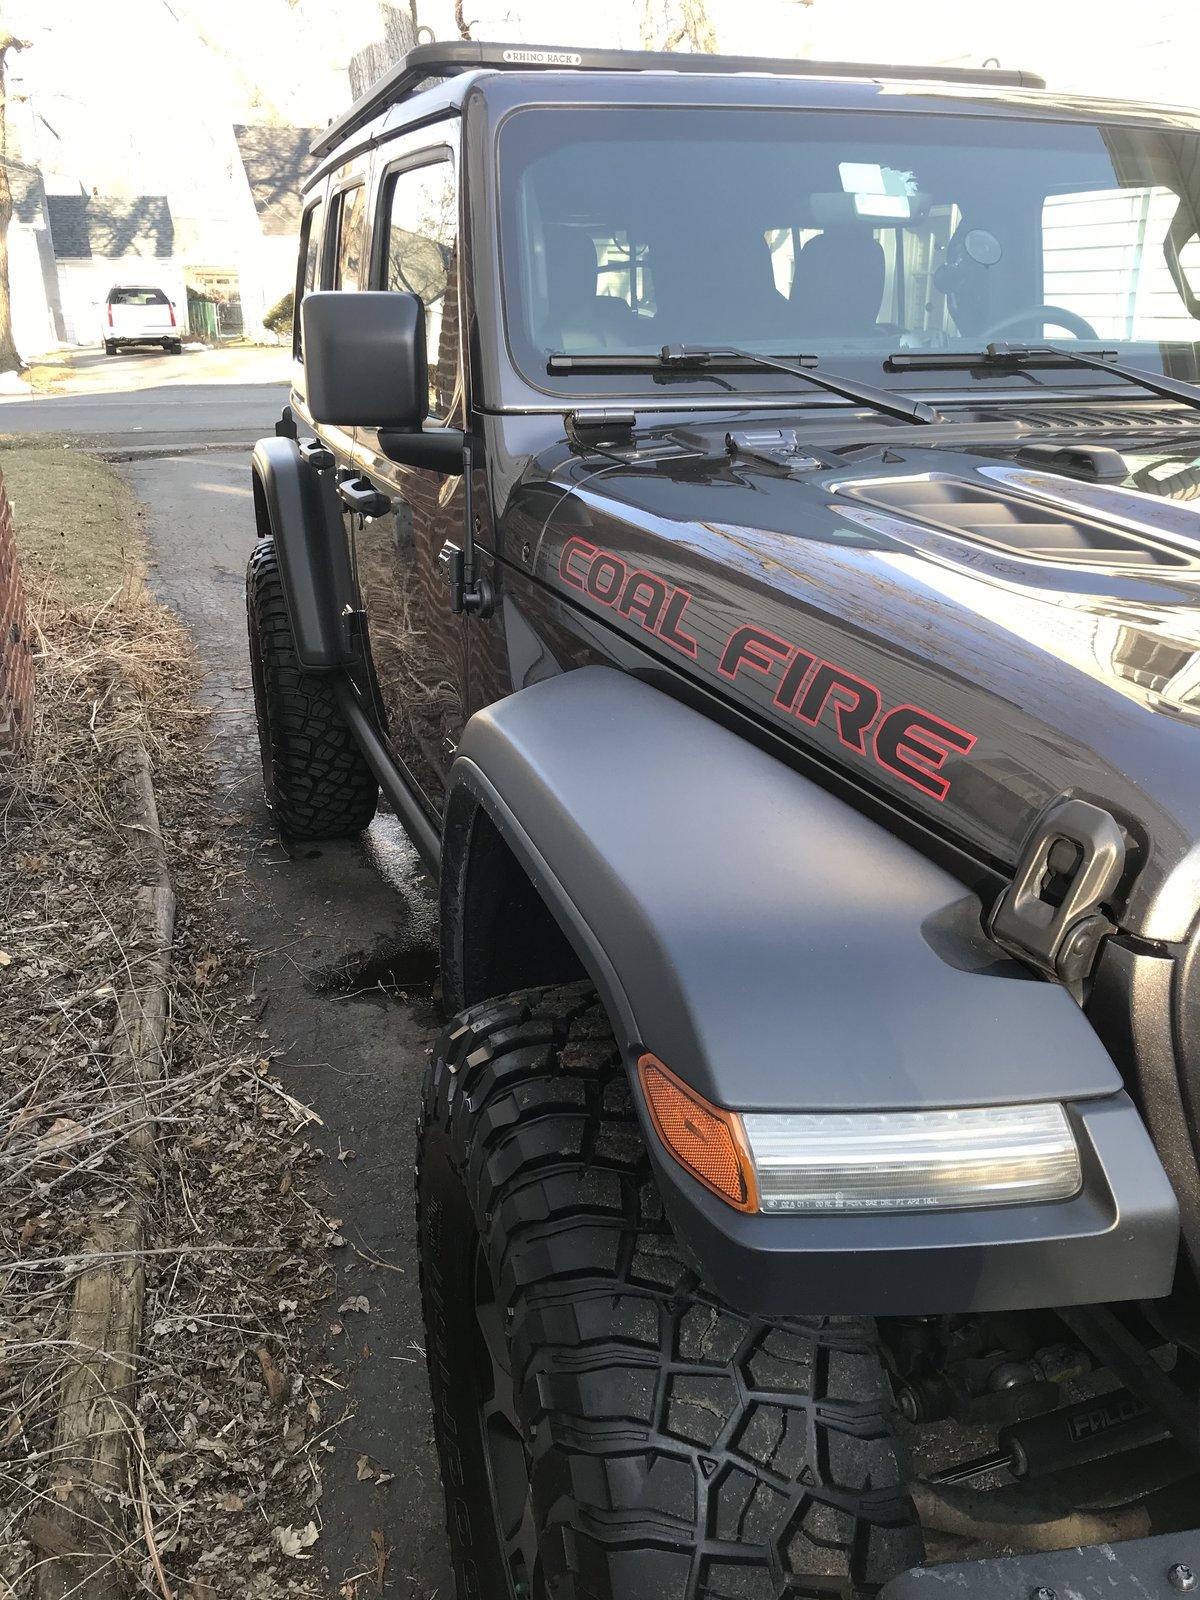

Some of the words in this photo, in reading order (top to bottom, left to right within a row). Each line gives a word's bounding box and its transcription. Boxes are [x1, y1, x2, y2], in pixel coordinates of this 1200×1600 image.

[513, 52, 544, 62] RHINO
[547, 54, 572, 64] RACK
[558, 535, 698, 659] COAL
[717, 624, 978, 801] FIRE
